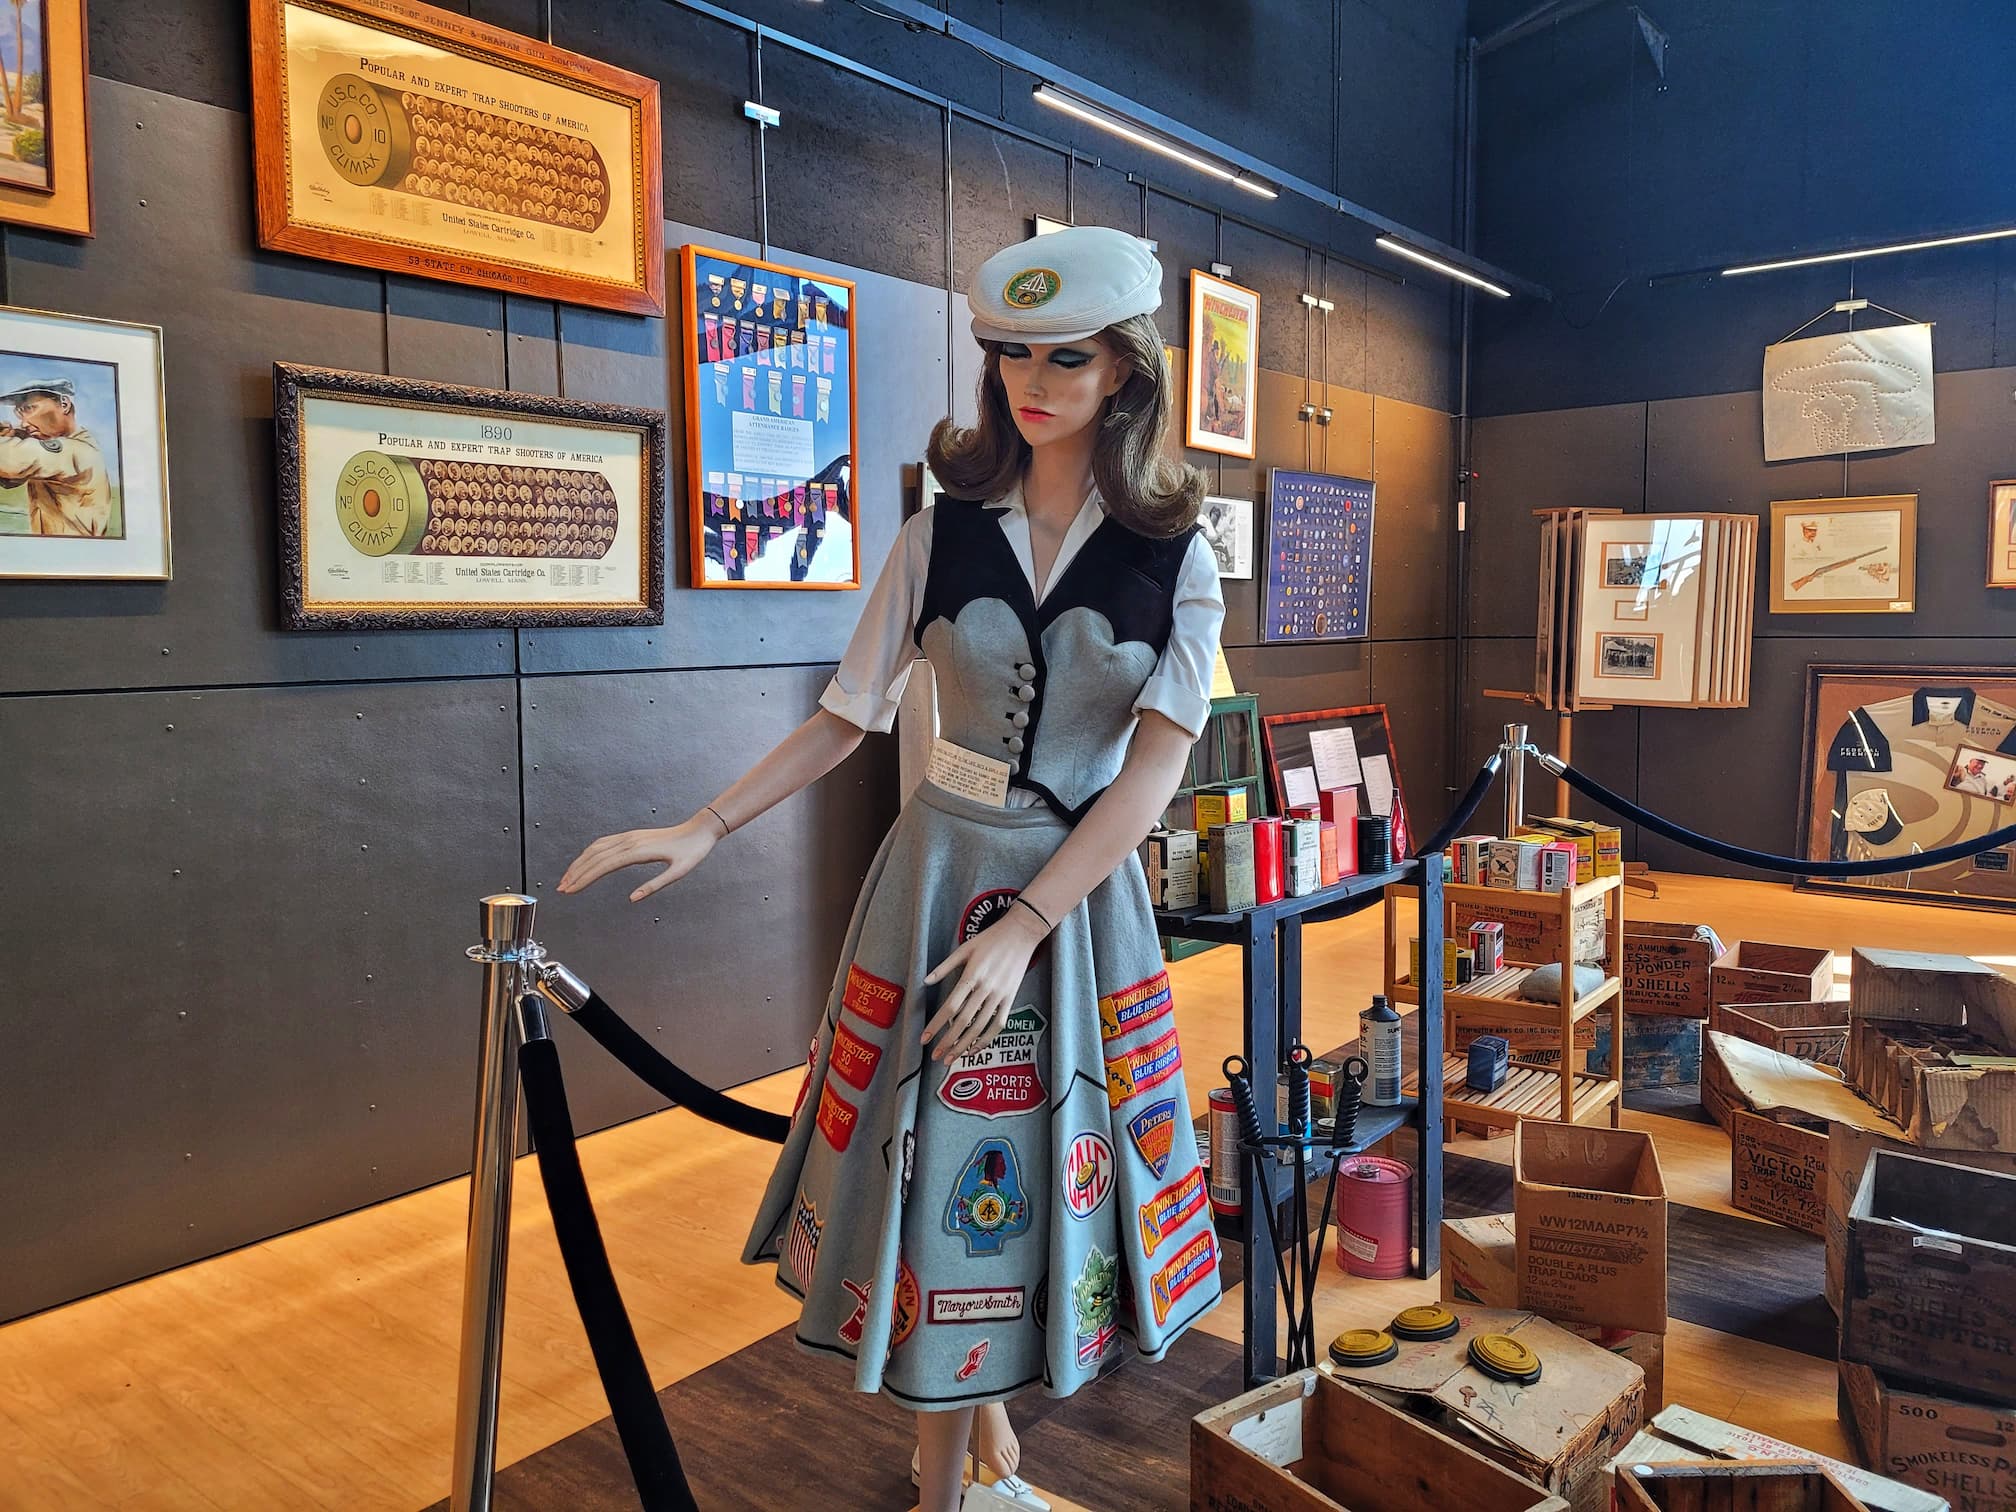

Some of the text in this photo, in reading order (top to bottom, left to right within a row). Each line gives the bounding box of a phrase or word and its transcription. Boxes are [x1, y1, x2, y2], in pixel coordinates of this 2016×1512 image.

[410, 73, 430, 88] AND
[435, 81, 469, 99] EXPERT
[472, 92, 497, 107] TRAP
[499, 100, 539, 118] SHOOTERS
[542, 112, 552, 123] OF
[555, 115, 590, 133] AMERICA
[330, 144, 380, 175] CLIMAX
[442, 212, 466, 226] United
[468, 218, 489, 231] States
[491, 223, 524, 239] Cartridge
[481, 424, 513, 441] 1890
[427, 440, 446, 451] AND
[451, 442, 484, 454] EXPERT
[488, 446, 511, 457] TRAP
[516, 448, 554, 459] SHOOTERS
[557, 451, 566, 460] OF
[570, 452, 604, 464] AMERICA
[348, 521, 399, 546] CLIMAX
[455, 567, 478, 577] United
[481, 567, 501, 577] States
[503, 568, 535, 578] Cartridge
[1509, 908, 1537, 920] SHELLS
[1635, 960, 1691, 976] POWDER
[1637, 977, 1691, 993] SHELLS
[1716, 975, 1727, 985] 12
[857, 991, 870, 1005] 25
[1113, 979, 1169, 1010] WINCHESTER
[1121, 989, 1169, 1022] BLUE RIBBON
[1005, 1019, 1035, 1031] OMEN
[988, 1034, 1035, 1050] MERICA
[1130, 1036, 1177, 1069] WINCHESTER
[961, 1049, 1031, 1068] TRAP TEAM
[1134, 1048, 1178, 1082] BLUE RIBBON
[985, 1073, 1032, 1087] SPORTS
[1105, 1066, 1132, 1094] TRAP
[986, 1087, 1028, 1100] AFIELD
[1141, 1109, 1172, 1134] PETERS
[1747, 1147, 1816, 1183] VICTOR
[1154, 1171, 1201, 1214] WINCHESTER
[1739, 1178, 1749, 1190] 3
[1781, 1174, 1814, 1191] LOADS
[1158, 1183, 1202, 1226] BLUE RIBBON
[1167, 1234, 1210, 1278] WINCHESTER
[1532, 1238, 1607, 1258] WINCHESTER
[1169, 1248, 1212, 1292] BLUE RIBBON
[1528, 1255, 1617, 1277] DOUBLE A PLUS
[1528, 1265, 1599, 1284] TRAP LOADS
[984, 1295, 1021, 1311] Smith
[1869, 1306, 2015, 1356] POINTER
[1899, 1404, 2015, 1433] 500 12
[1891, 1451, 1990, 1473] SMOKELESS
